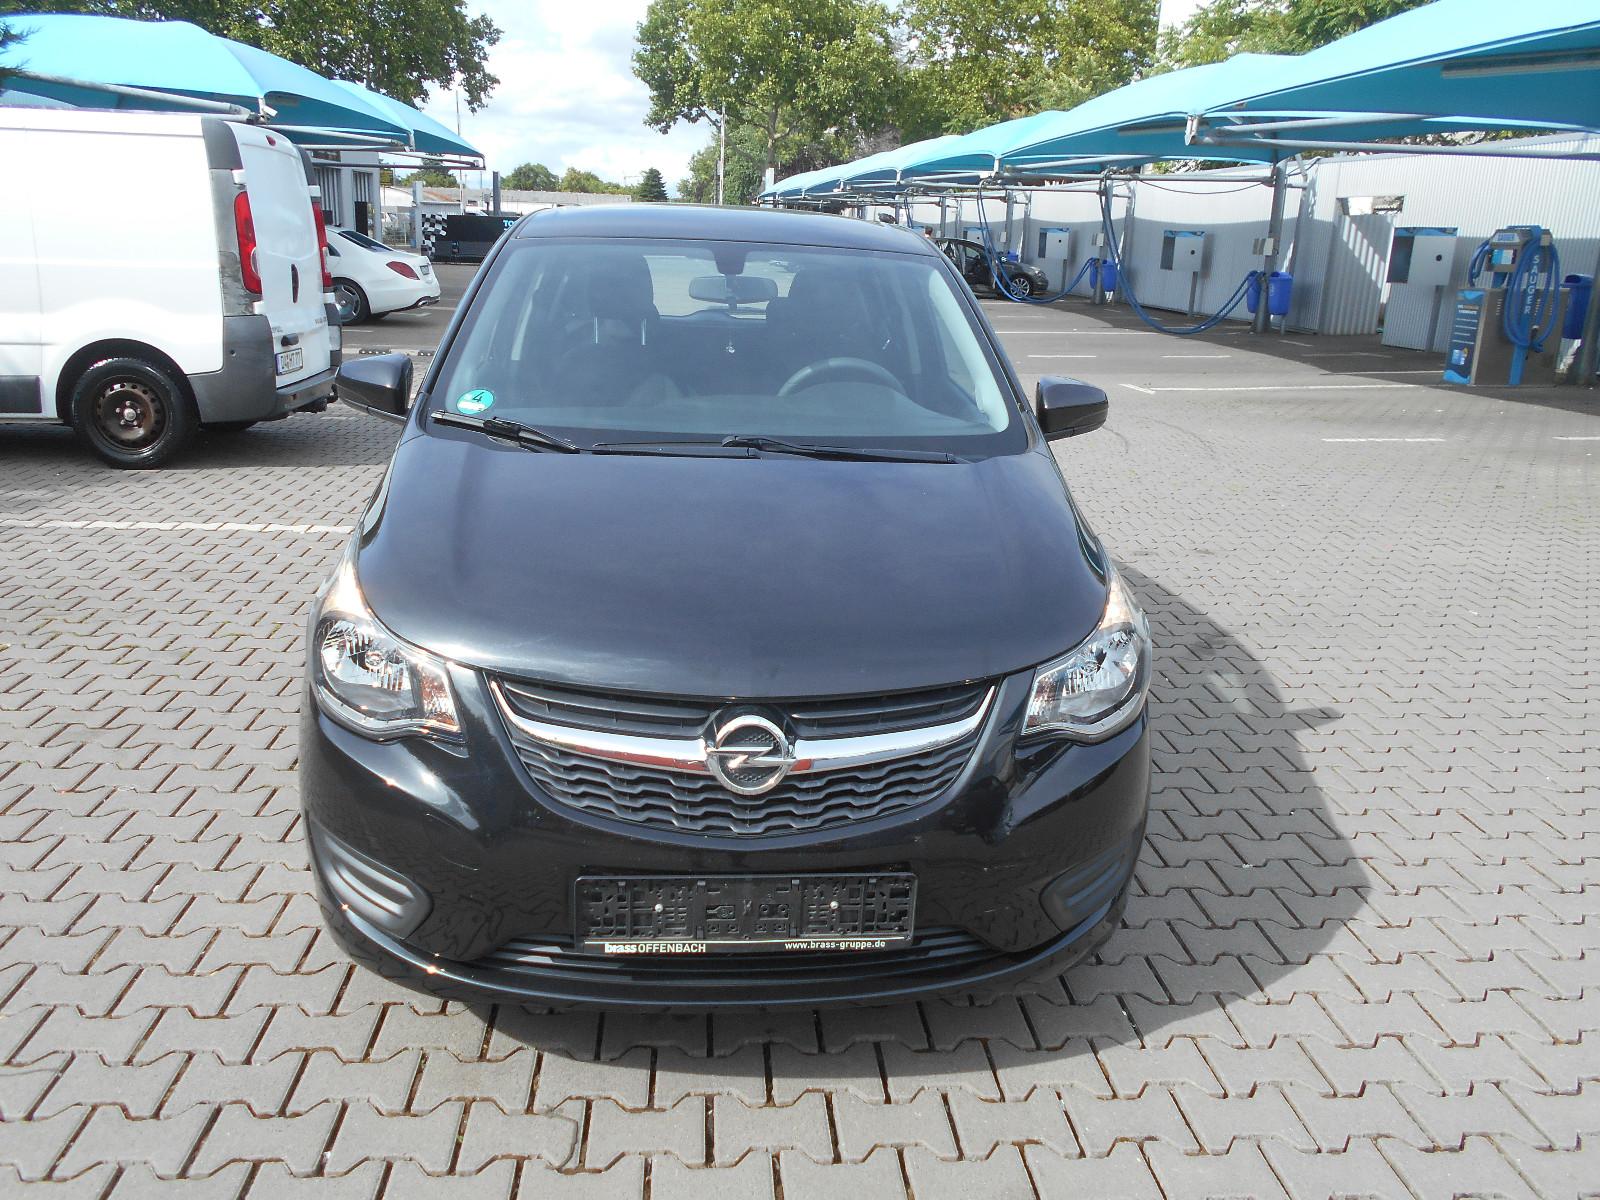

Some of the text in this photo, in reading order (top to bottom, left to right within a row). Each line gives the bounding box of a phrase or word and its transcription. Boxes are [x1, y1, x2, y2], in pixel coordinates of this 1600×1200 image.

[1524, 255, 1540, 314] SAUGER
[472, 391, 484, 402] 4
[784, 940, 886, 950] www.brass-gruppe.de
